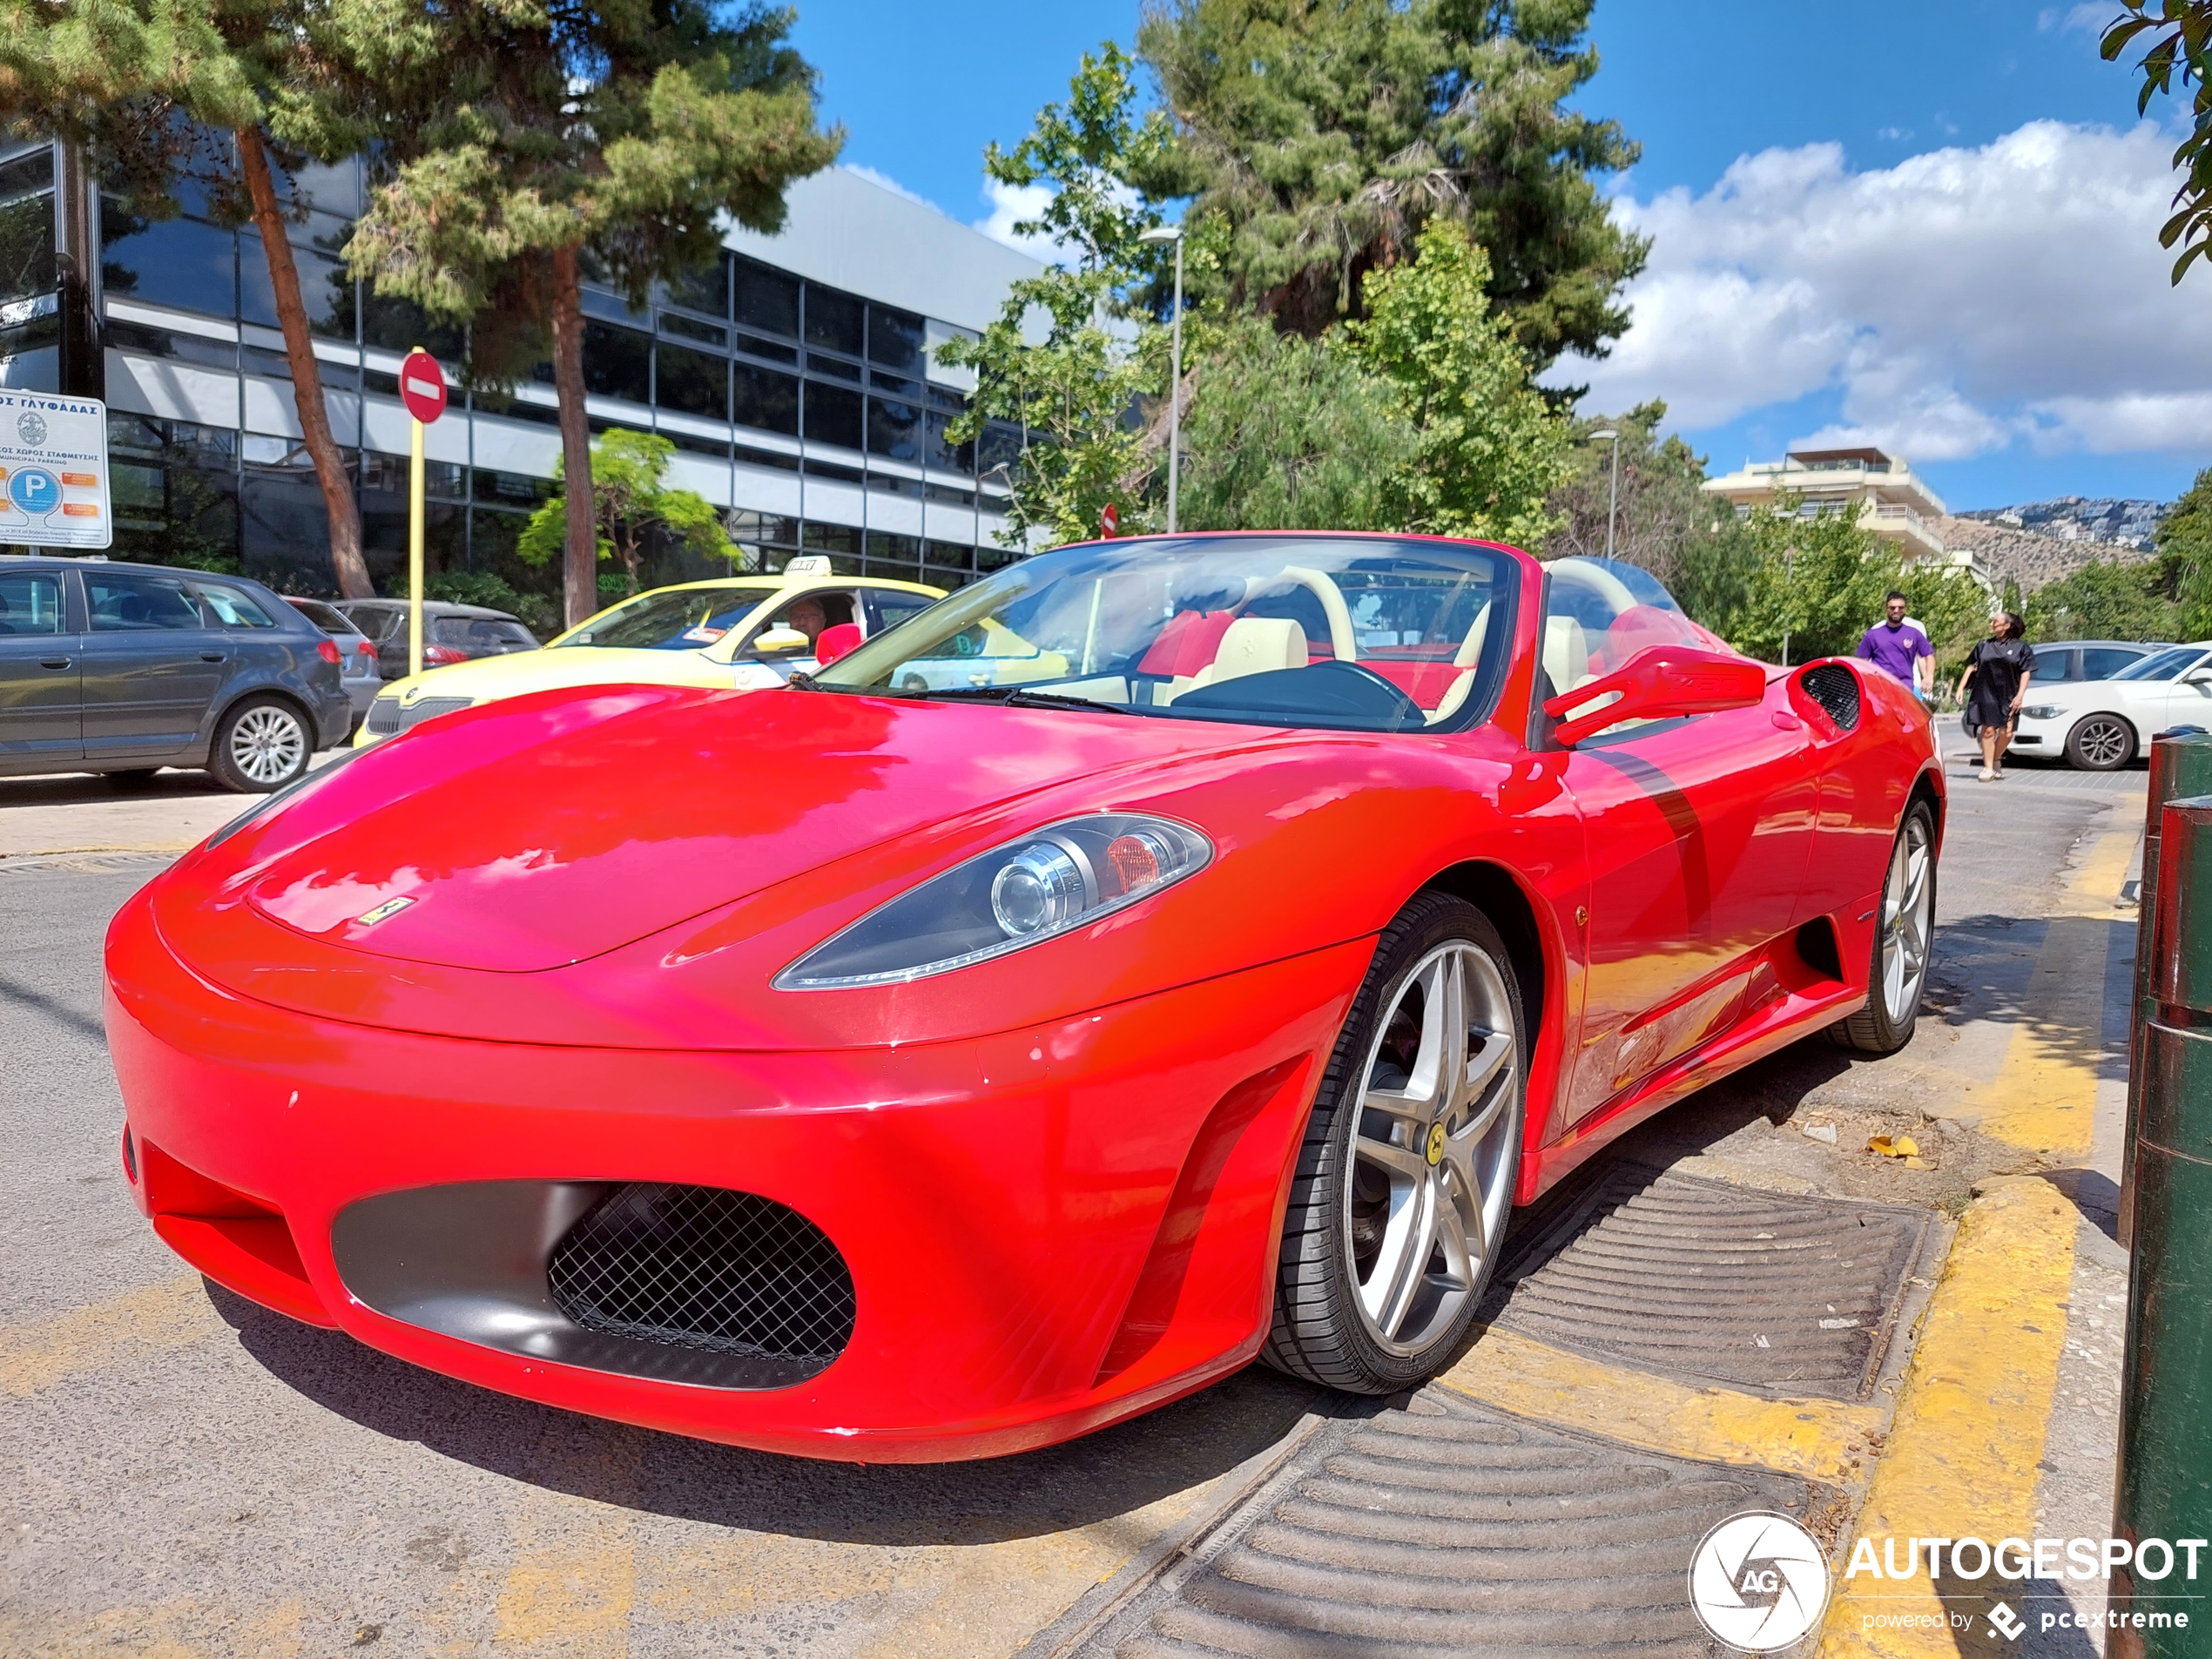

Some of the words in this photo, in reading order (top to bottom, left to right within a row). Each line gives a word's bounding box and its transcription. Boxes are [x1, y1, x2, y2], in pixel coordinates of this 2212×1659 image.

[21, 399, 98, 415] ΓΛΥΦΑΔΑΣ
[17, 448, 44, 456] ΧΩΡΟΣ
[25, 475, 46, 497] P
